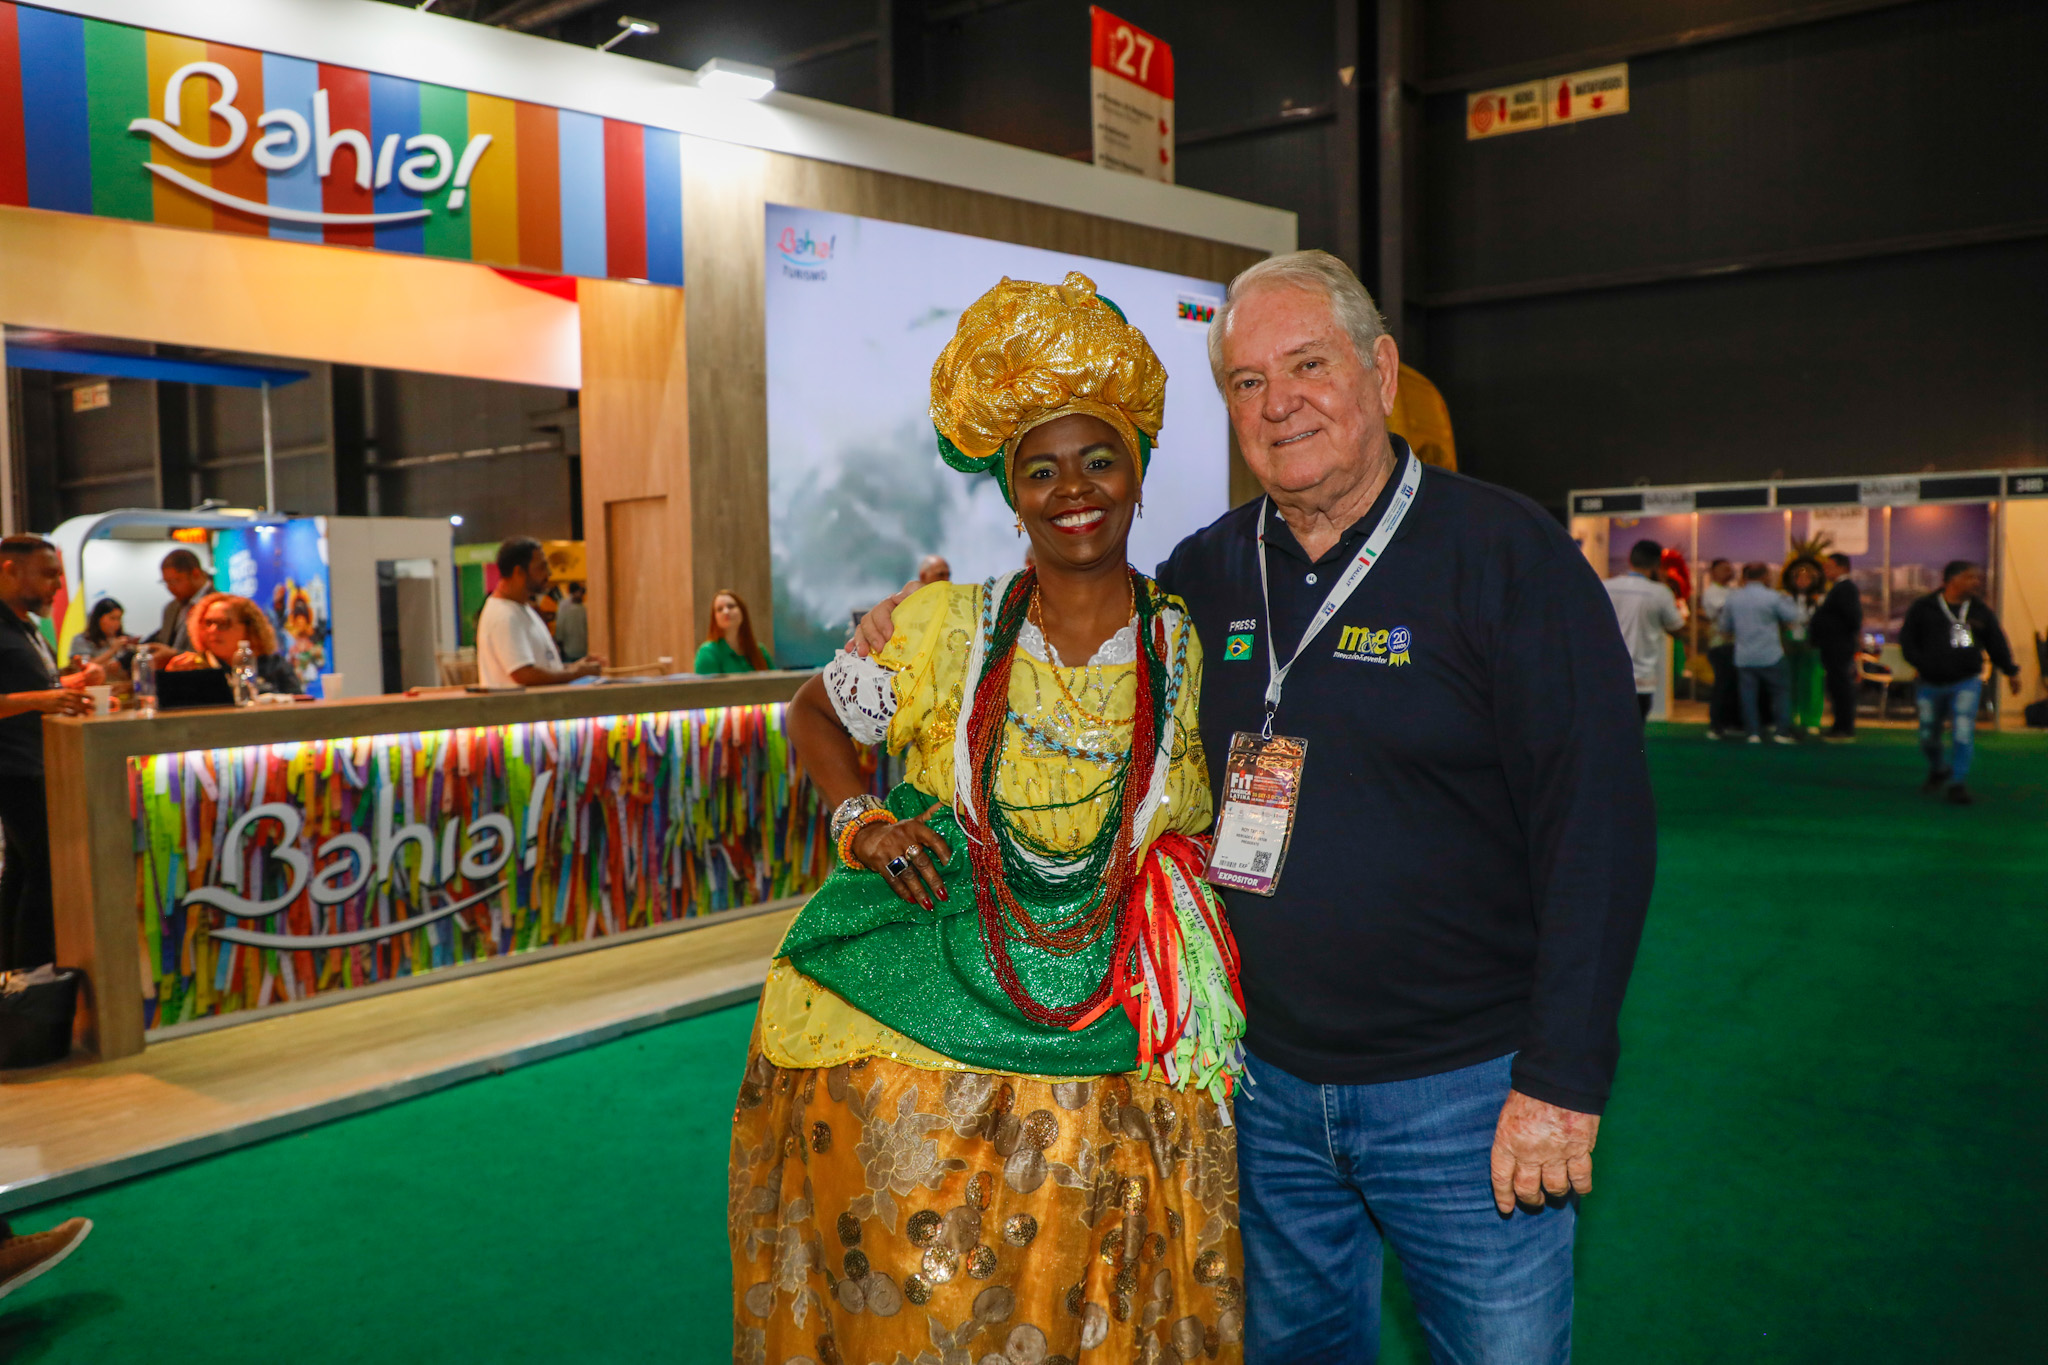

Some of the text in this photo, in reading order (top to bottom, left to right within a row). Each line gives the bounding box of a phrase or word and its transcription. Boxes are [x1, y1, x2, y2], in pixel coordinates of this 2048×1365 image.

[1116, 25, 1154, 82] 27
[128, 61, 493, 210] Bahia!
[1229, 618, 1257, 632] PRESS
[1337, 625, 1390, 655] m&e
[1392, 631, 1407, 645] 20
[182, 769, 552, 917] Bahia!
[1218, 871, 1259, 887] EXPOSITOR
[1187, 900, 1207, 932] BAHIA
[1202, 905, 1212, 919] DO
[1150, 921, 1158, 935] DO
[1210, 923, 1238, 985] LEMBRANÇA
